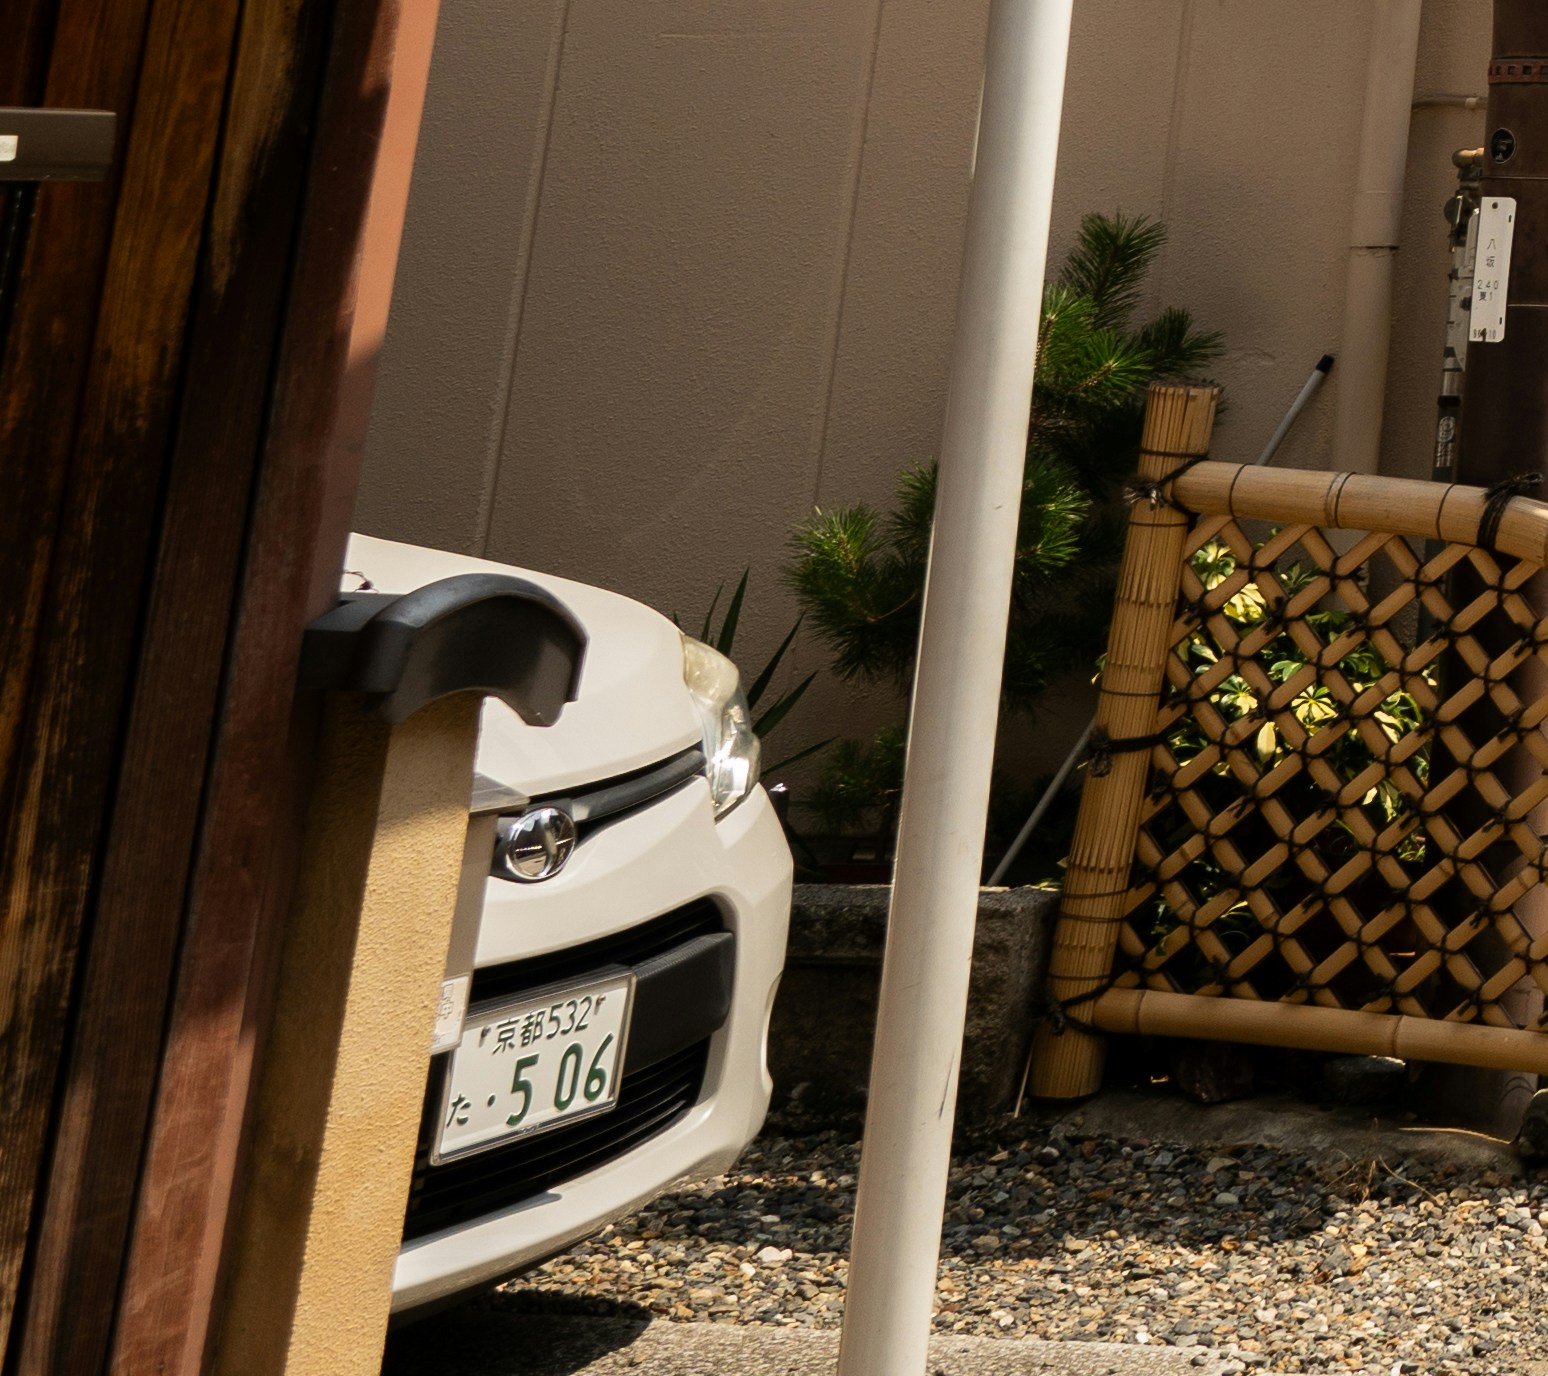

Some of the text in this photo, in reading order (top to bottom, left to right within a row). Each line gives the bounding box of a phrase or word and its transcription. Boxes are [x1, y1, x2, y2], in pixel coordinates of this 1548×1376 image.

[1485, 238, 1498, 268] 八坂
[1477, 279, 1499, 290] 240
[492, 995, 593, 1056] 京都 532
[446, 1093, 472, 1129] た
